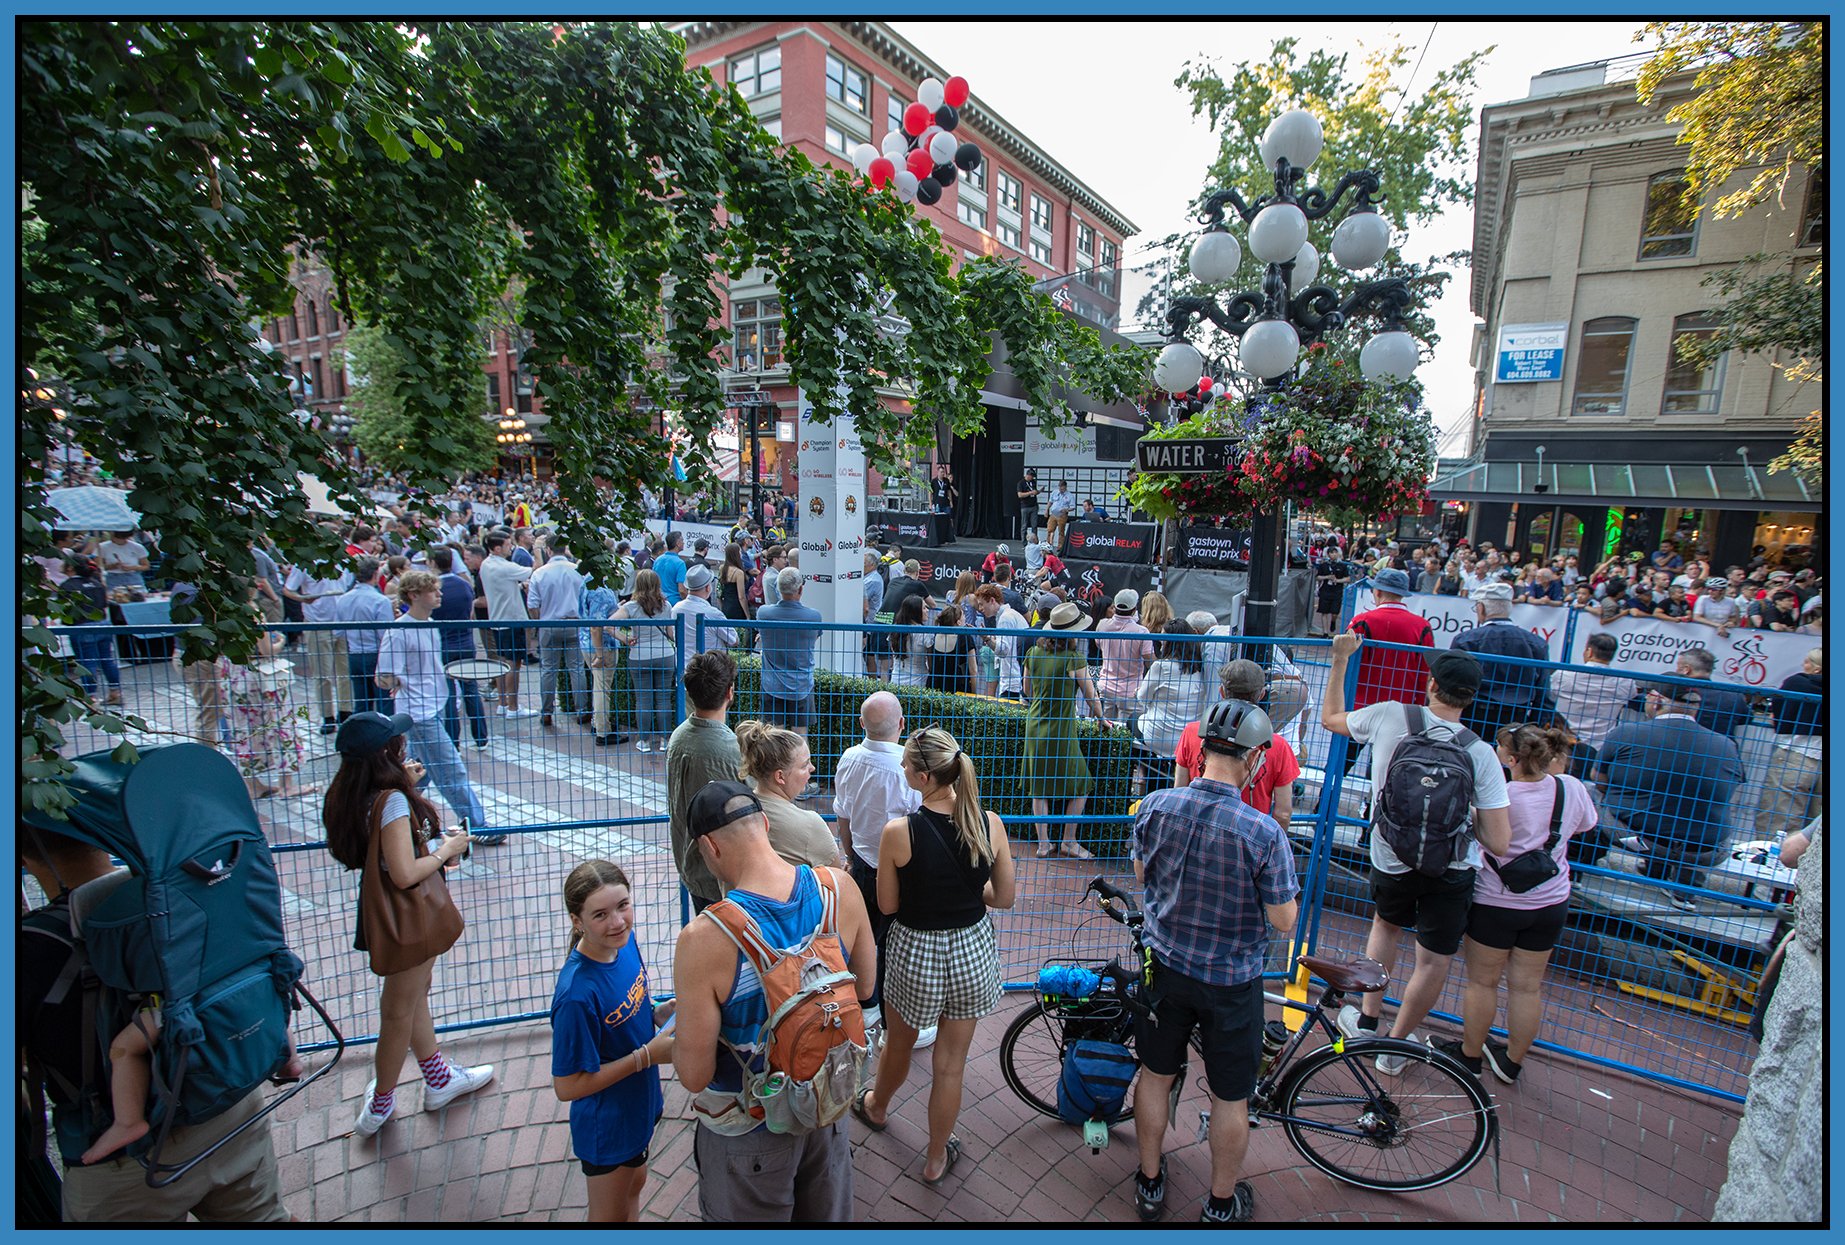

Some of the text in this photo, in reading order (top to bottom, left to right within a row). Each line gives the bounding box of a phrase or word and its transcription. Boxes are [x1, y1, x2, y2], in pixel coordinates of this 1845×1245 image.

[1508, 350, 1555, 361] FOR LEASE
[810, 440, 832, 450] Champion
[1146, 445, 1205, 467] WATER
[801, 542, 828, 552] Global
[838, 540, 859, 550] Global
[1188, 536, 1232, 548] gastown
[1187, 547, 1240, 560] grand prix
[1620, 632, 1706, 650] gastown
[1617, 648, 1678, 665] grand
